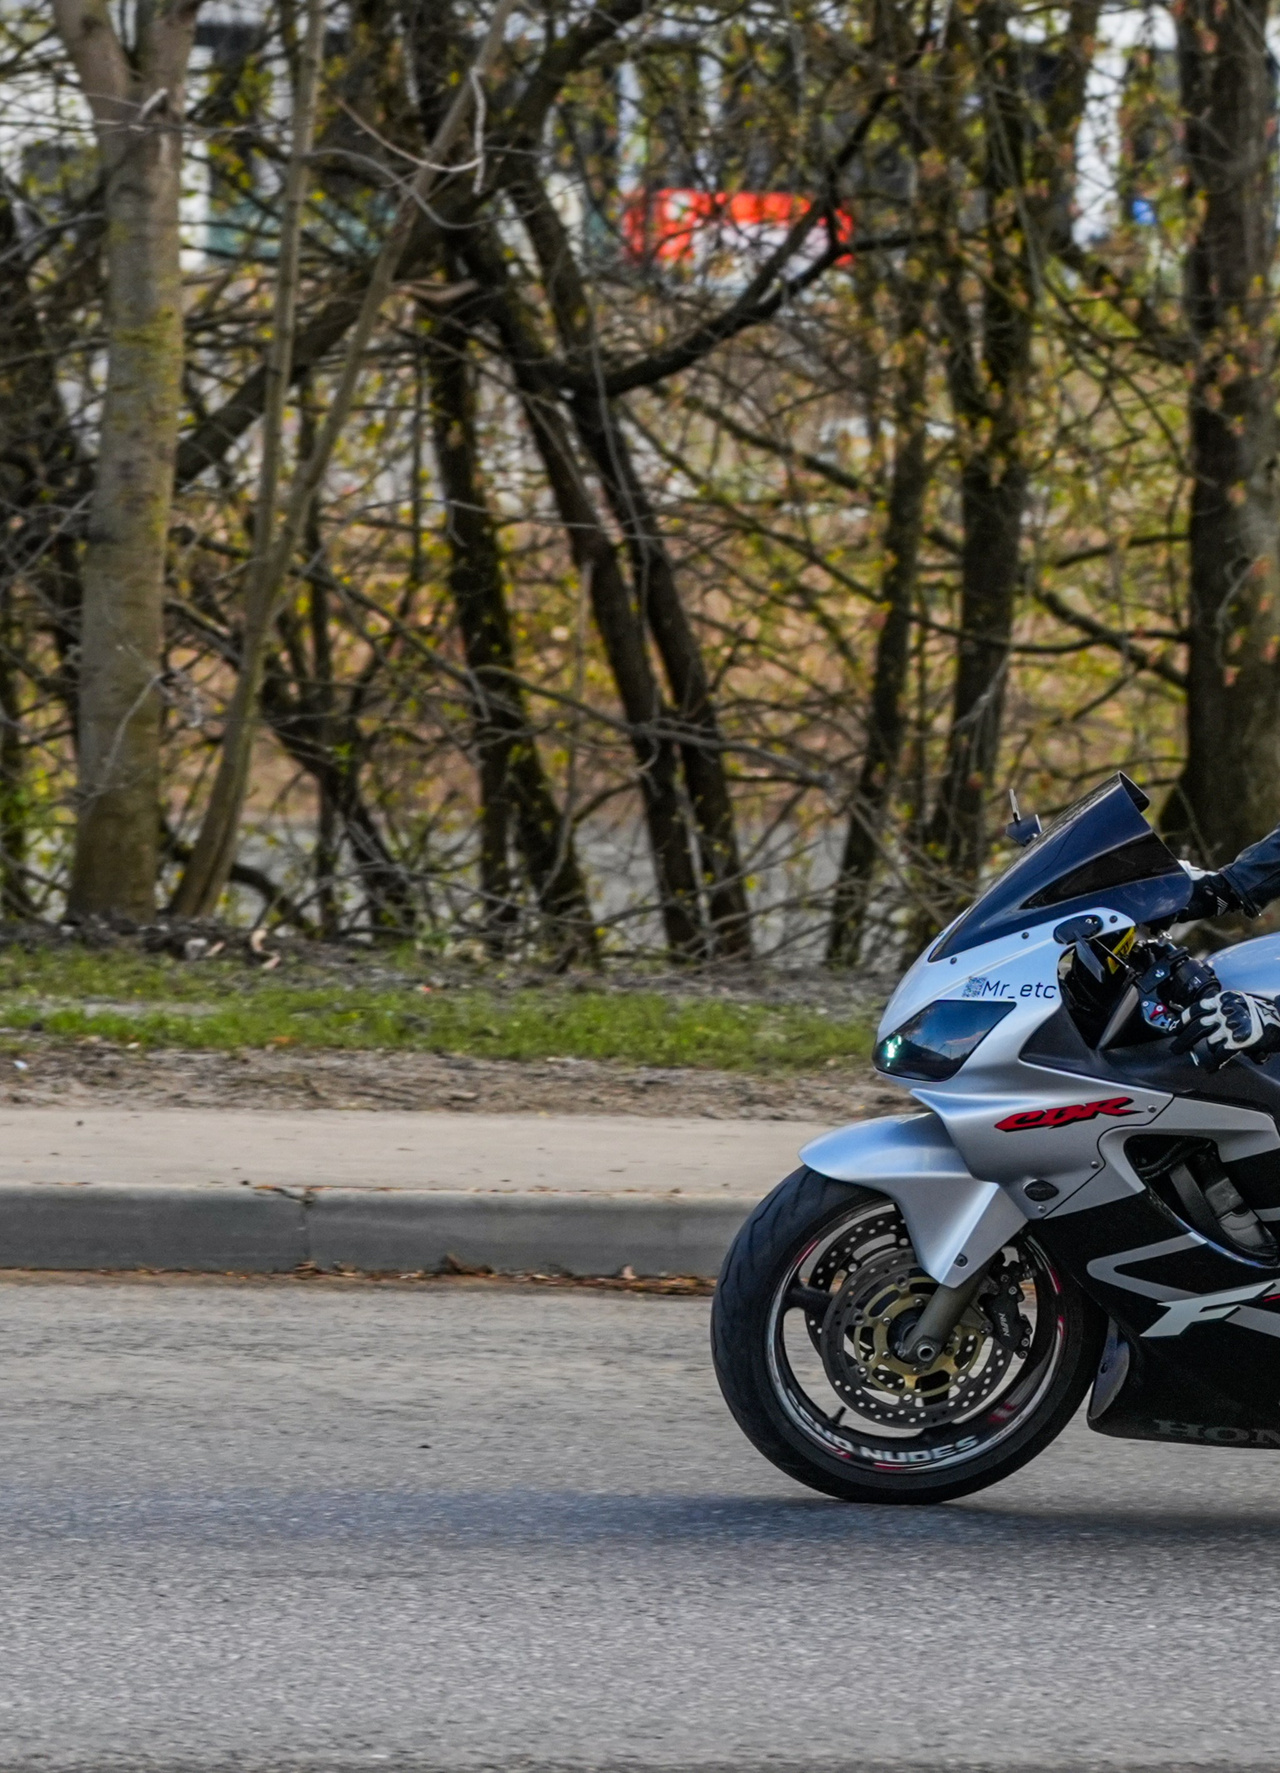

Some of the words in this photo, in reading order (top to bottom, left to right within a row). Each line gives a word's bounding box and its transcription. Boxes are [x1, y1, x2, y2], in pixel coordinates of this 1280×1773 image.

[983, 978, 1056, 1001] Mr_etc
[994, 1096, 1141, 1132] CBR
[859, 1435, 979, 1463] NUDES
